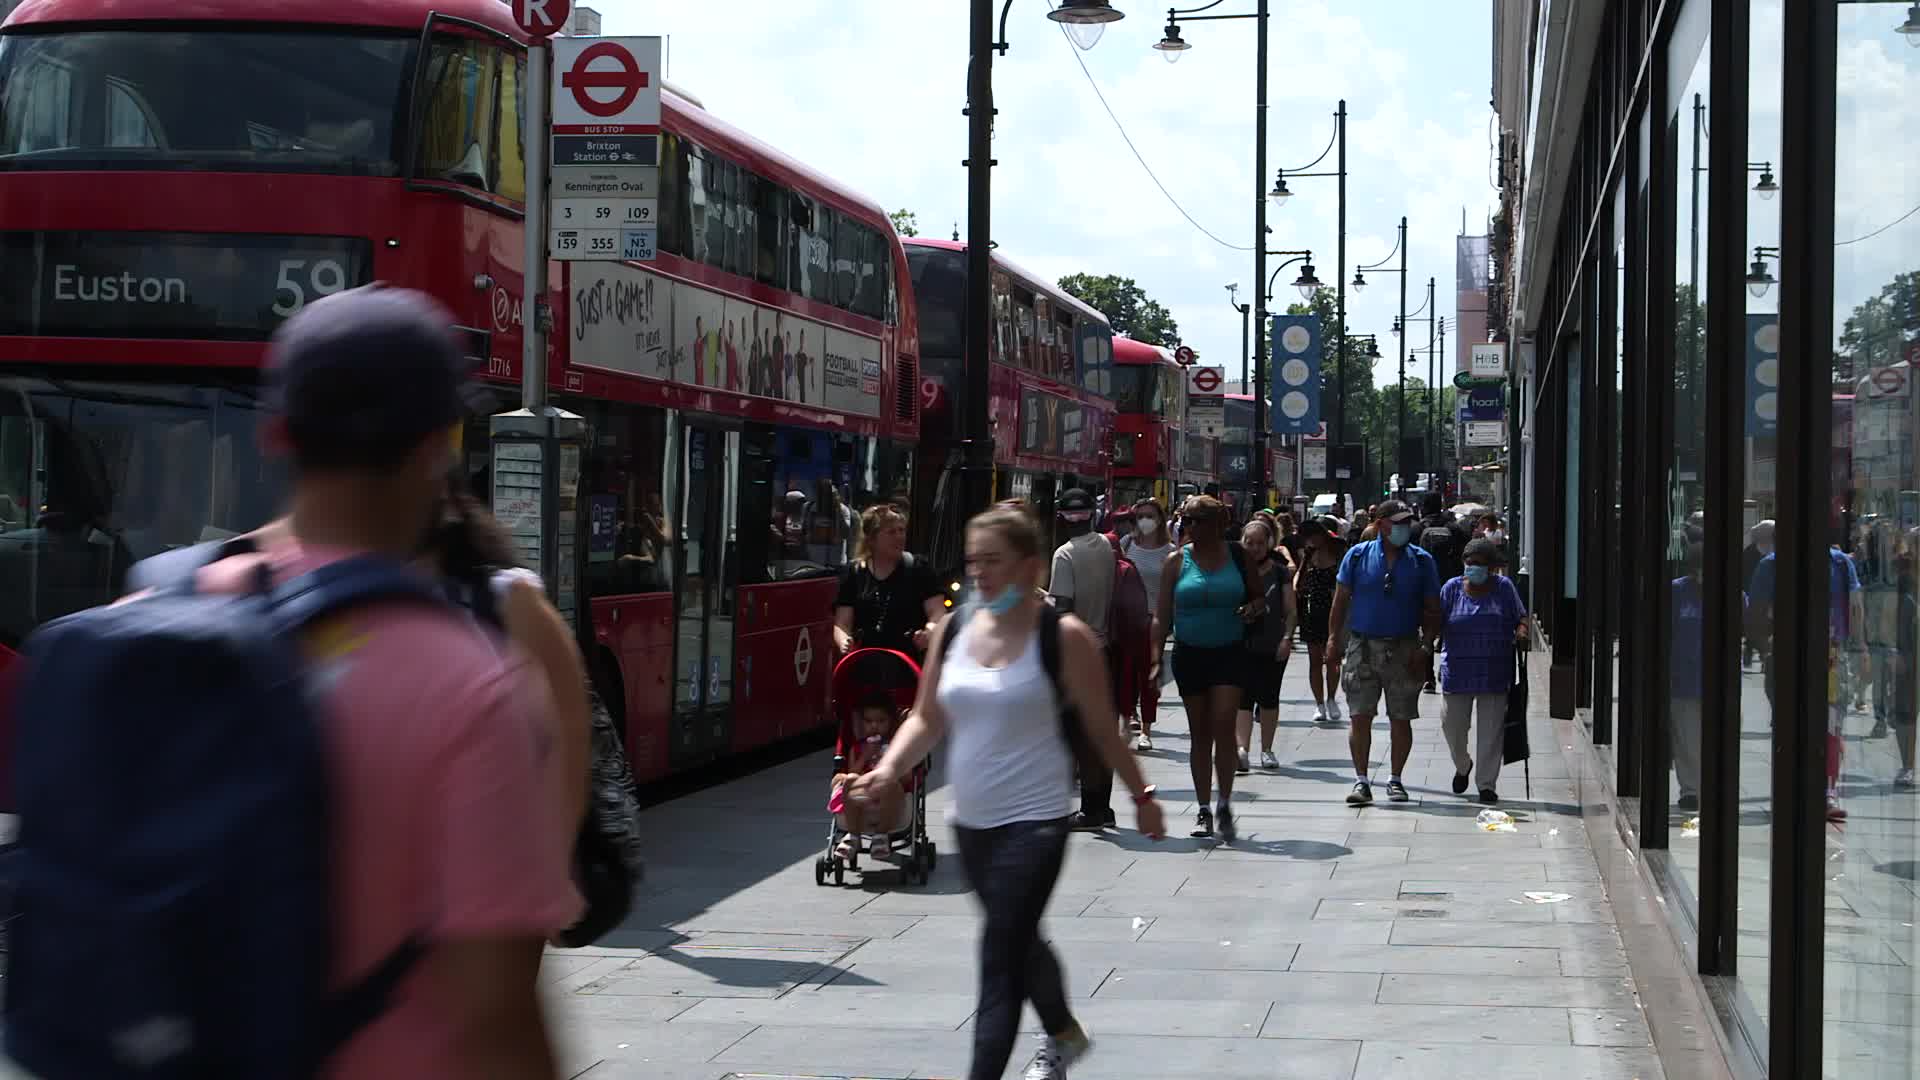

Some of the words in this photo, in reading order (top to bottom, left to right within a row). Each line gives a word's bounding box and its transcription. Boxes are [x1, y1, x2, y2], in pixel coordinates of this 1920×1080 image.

[523, 0, 553, 26] R
[586, 142, 621, 150] Brixton
[573, 152, 607, 160] Station
[565, 182, 618, 192] Kennington
[621, 182, 644, 191] Oval
[564, 207, 572, 218] 3
[595, 207, 611, 218] 59
[628, 207, 649, 218] 109
[557, 238, 577, 249] 159
[591, 238, 614, 249] 355
[631, 238, 646, 247] N3
[624, 249, 652, 258] N109
[54, 264, 186, 303] Euston
[575, 278, 605, 341] JUST
[606, 287, 613, 318] A
[1179, 350, 1188, 362] S
[921, 378, 938, 409] 9
[1230, 457, 1247, 470] 45
